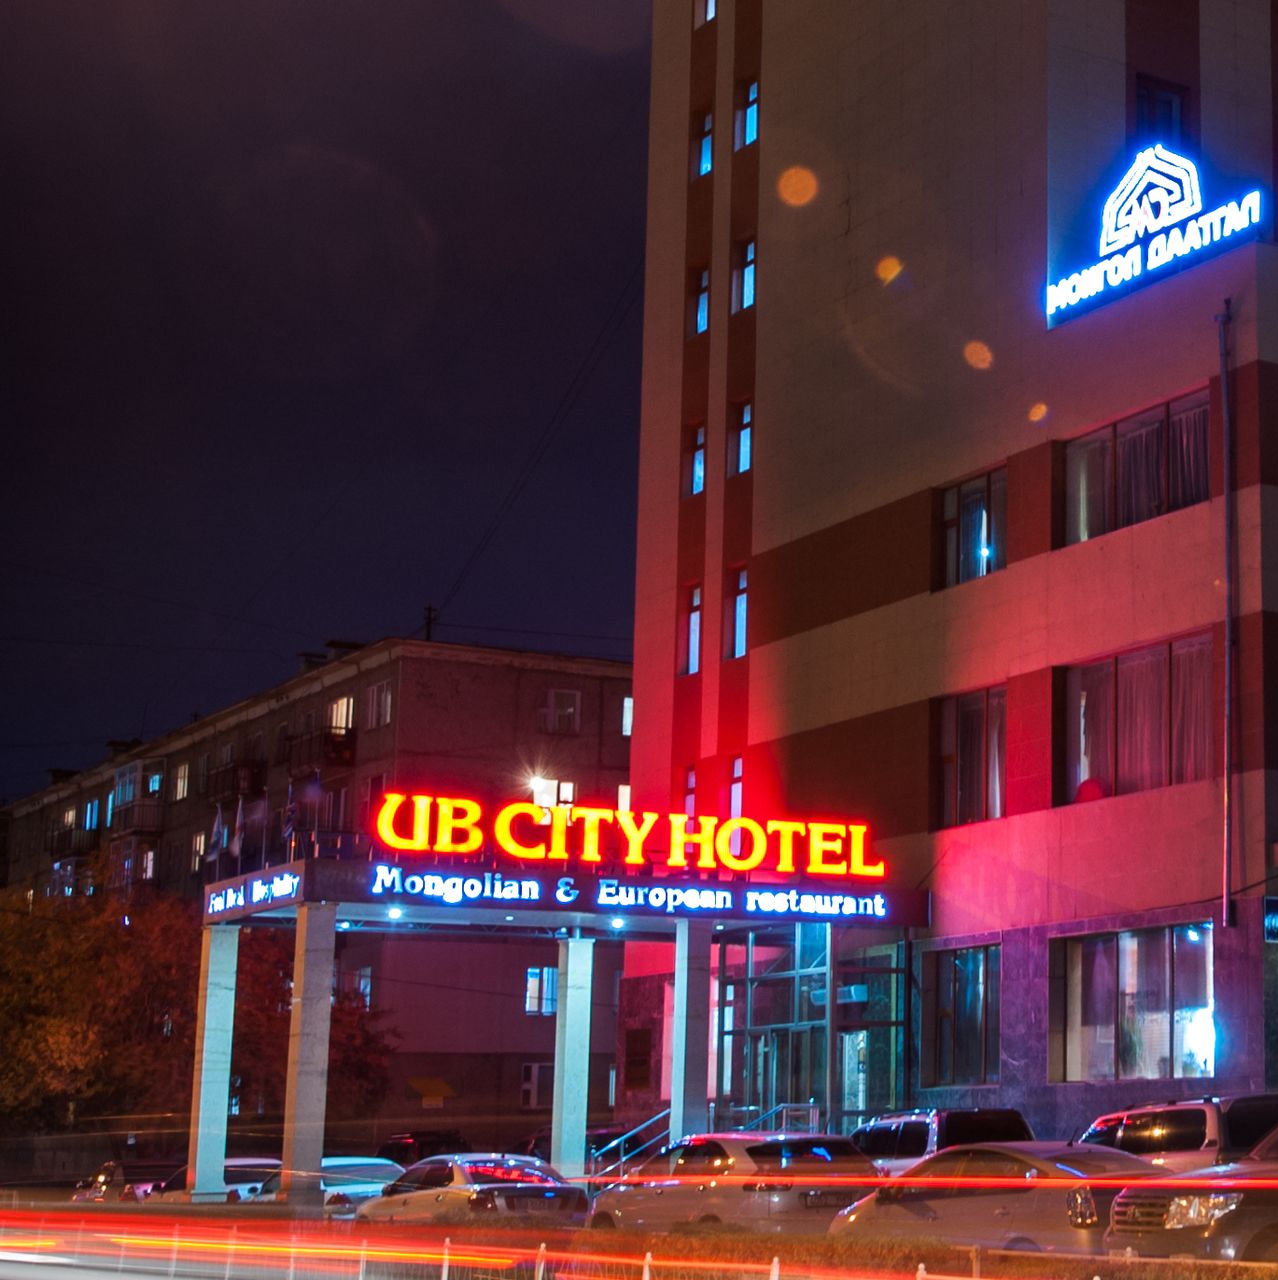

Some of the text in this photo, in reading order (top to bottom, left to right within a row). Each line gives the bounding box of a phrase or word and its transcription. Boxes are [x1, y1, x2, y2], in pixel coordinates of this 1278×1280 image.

[375, 791, 886, 877] UB CITY HOTEL
[371, 865, 887, 916] Mongolian & European restaurant
